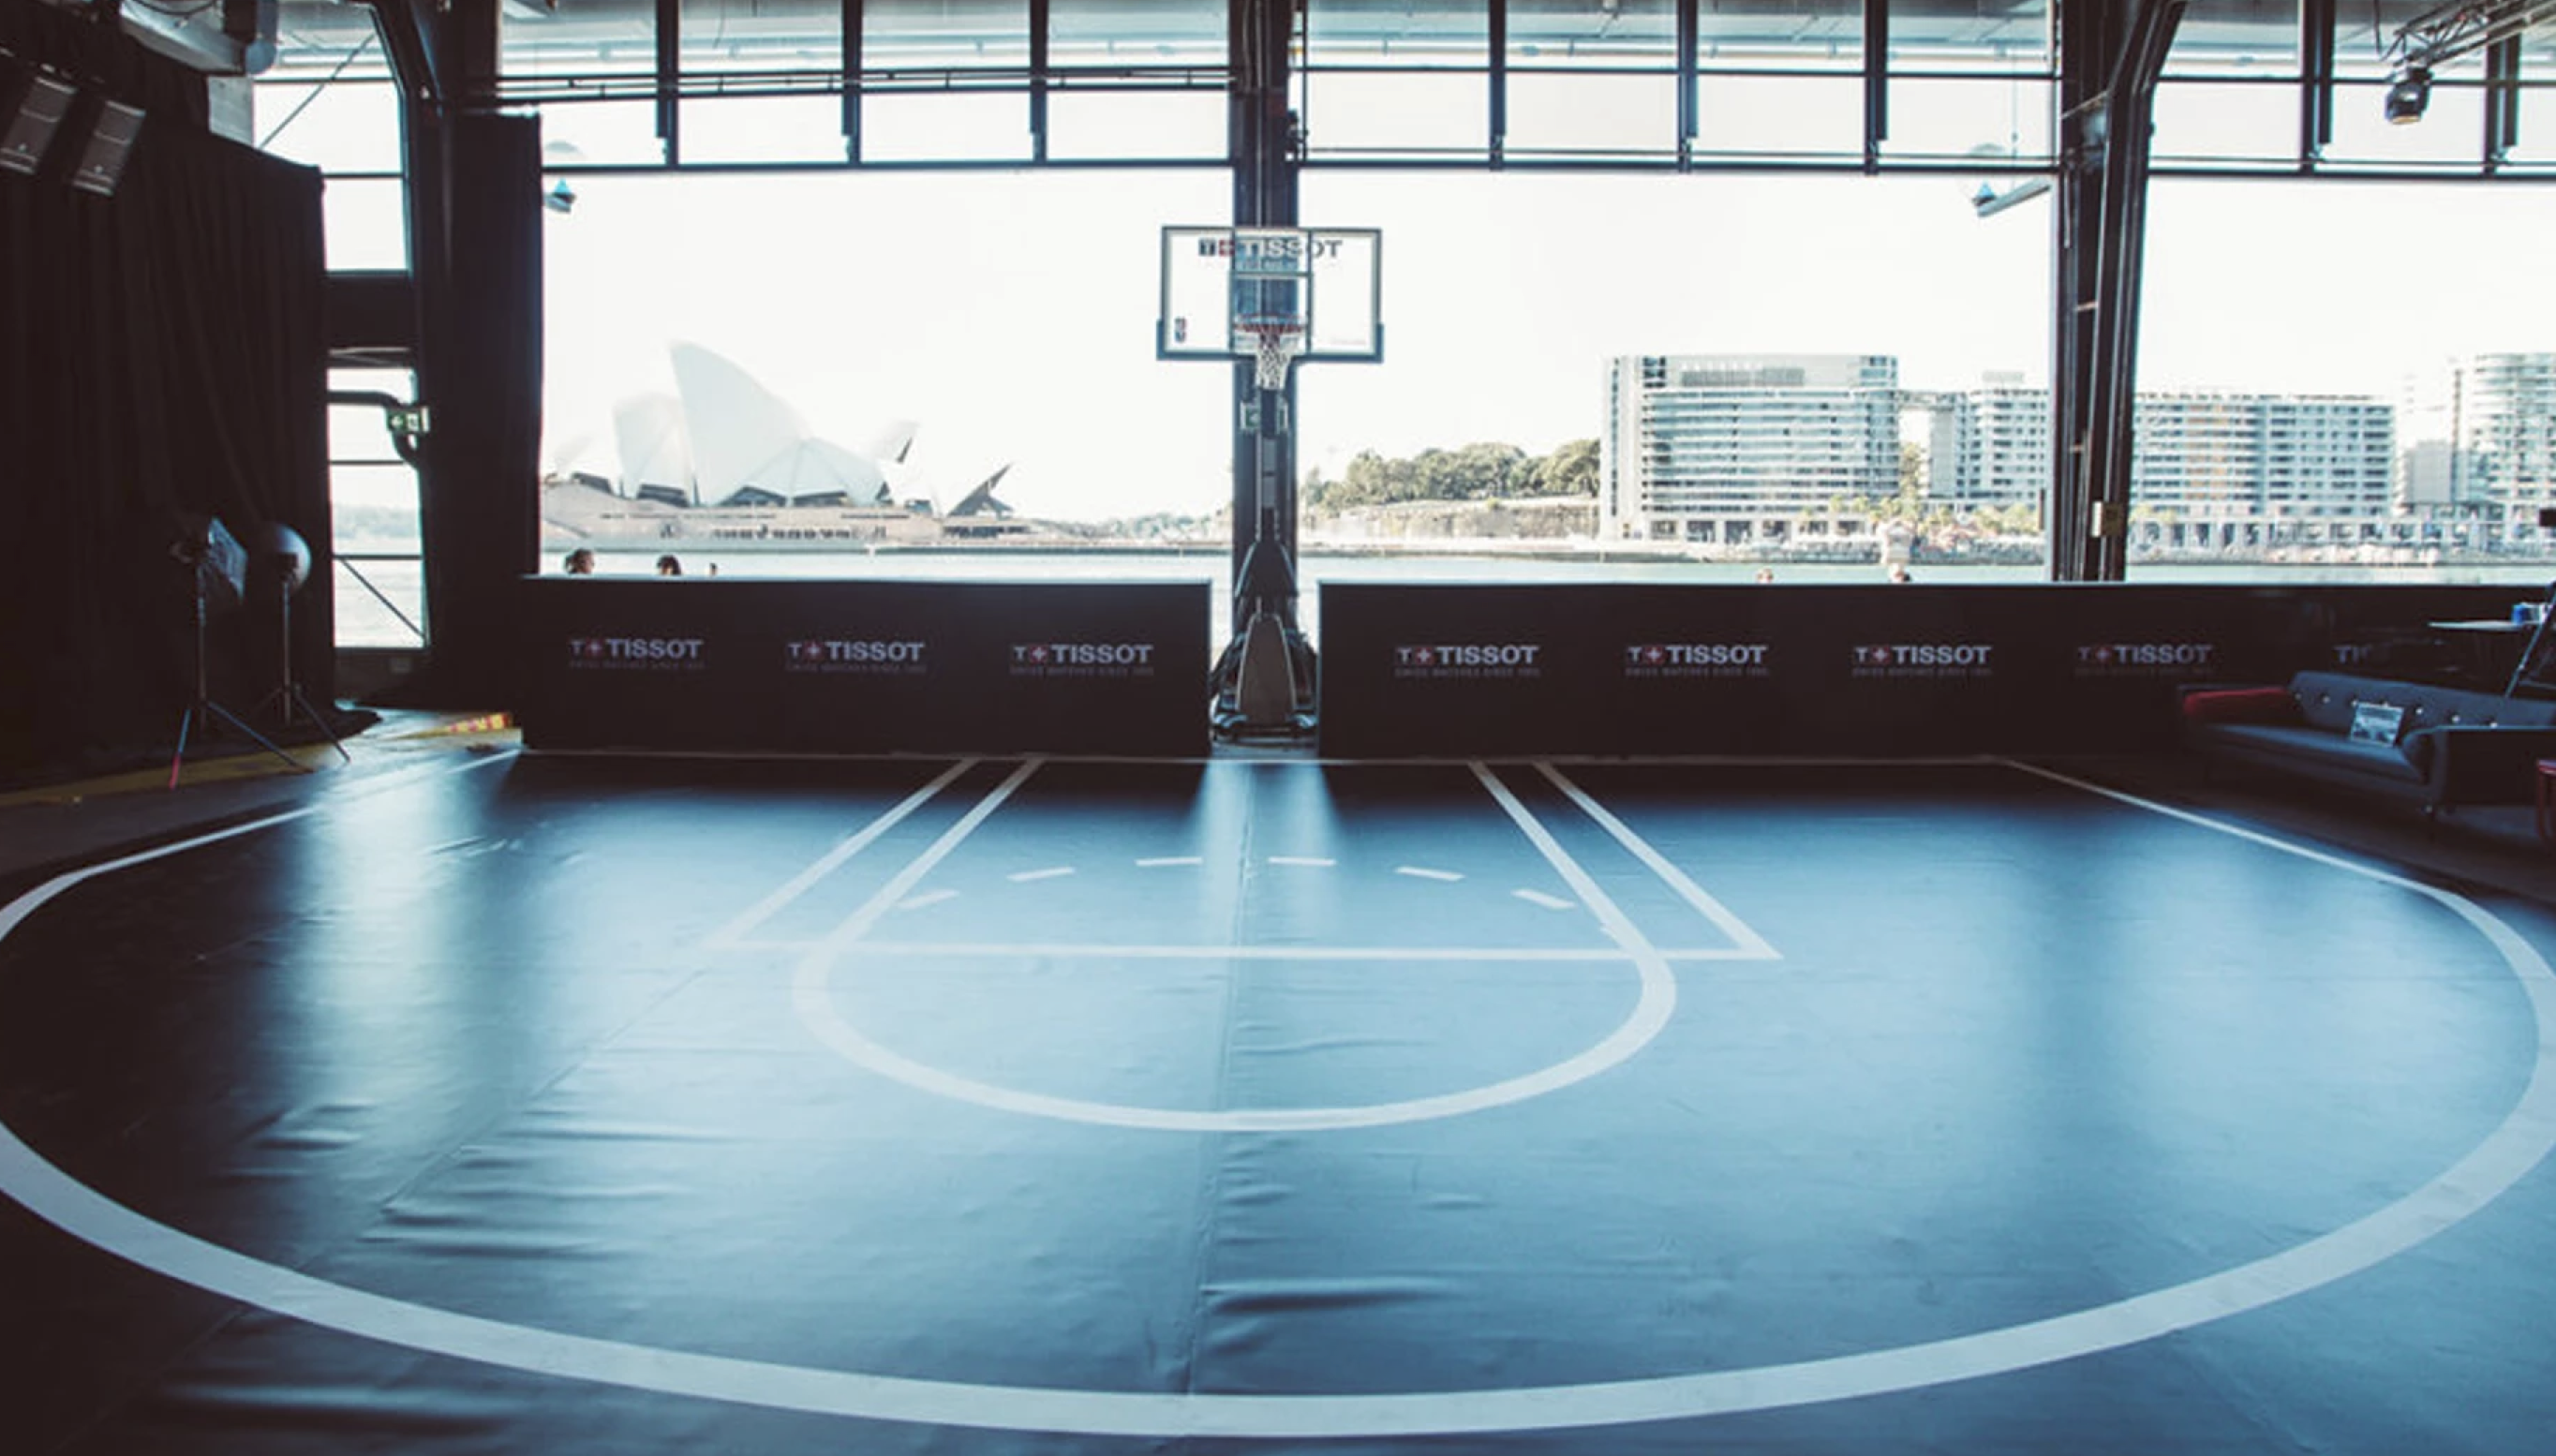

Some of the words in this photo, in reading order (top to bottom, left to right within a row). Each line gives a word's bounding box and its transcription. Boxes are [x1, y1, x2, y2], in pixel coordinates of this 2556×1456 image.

[1239, 238, 1343, 259] TISSOT
[607, 638, 704, 659] TISSOT
[825, 641, 925, 661] TISSOT
[1050, 643, 1154, 663] TISSOT
[1436, 645, 1539, 665] TISSOT
[1665, 644, 1769, 664] TISSOT
[1892, 645, 1993, 665] TISSOT
[2114, 644, 2213, 664] TISSOT
